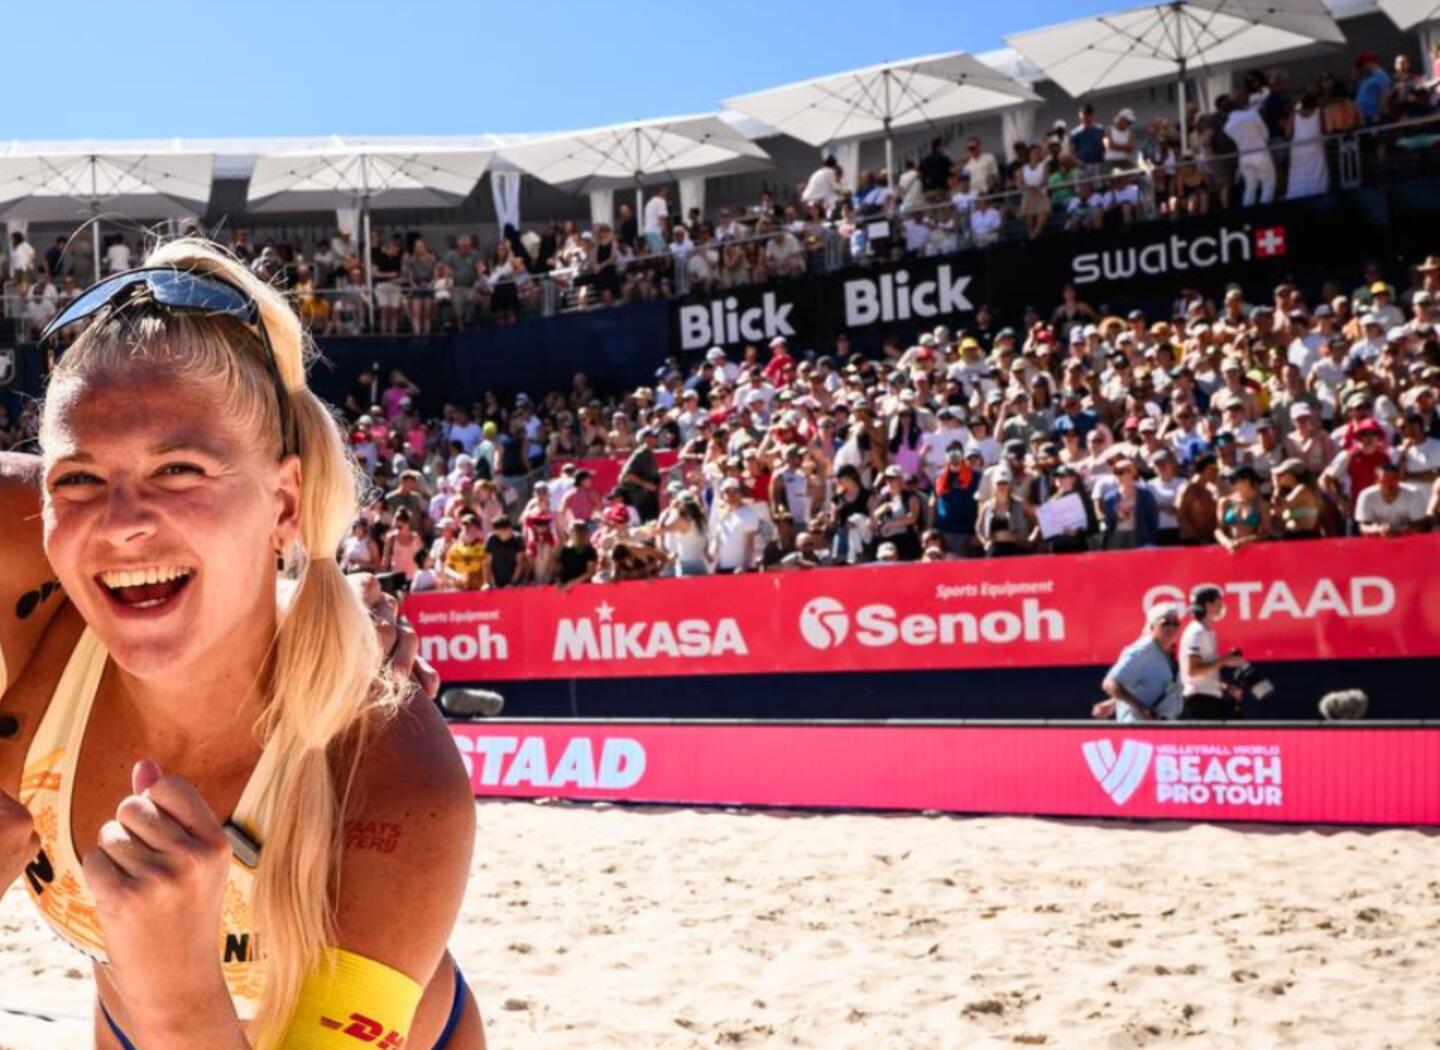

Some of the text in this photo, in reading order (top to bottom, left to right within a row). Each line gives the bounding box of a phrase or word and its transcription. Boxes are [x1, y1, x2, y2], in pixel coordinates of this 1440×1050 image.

[1072, 226, 1251, 284] swatch
[844, 264, 974, 327] Blick
[679, 292, 796, 350] Blick
[936, 580, 1053, 600] Sports Equipment
[421, 624, 508, 661] noh
[856, 598, 1066, 647] Senoh
[1155, 754, 1282, 785] BEACH
[1156, 782, 1283, 806] PRO TOUR
